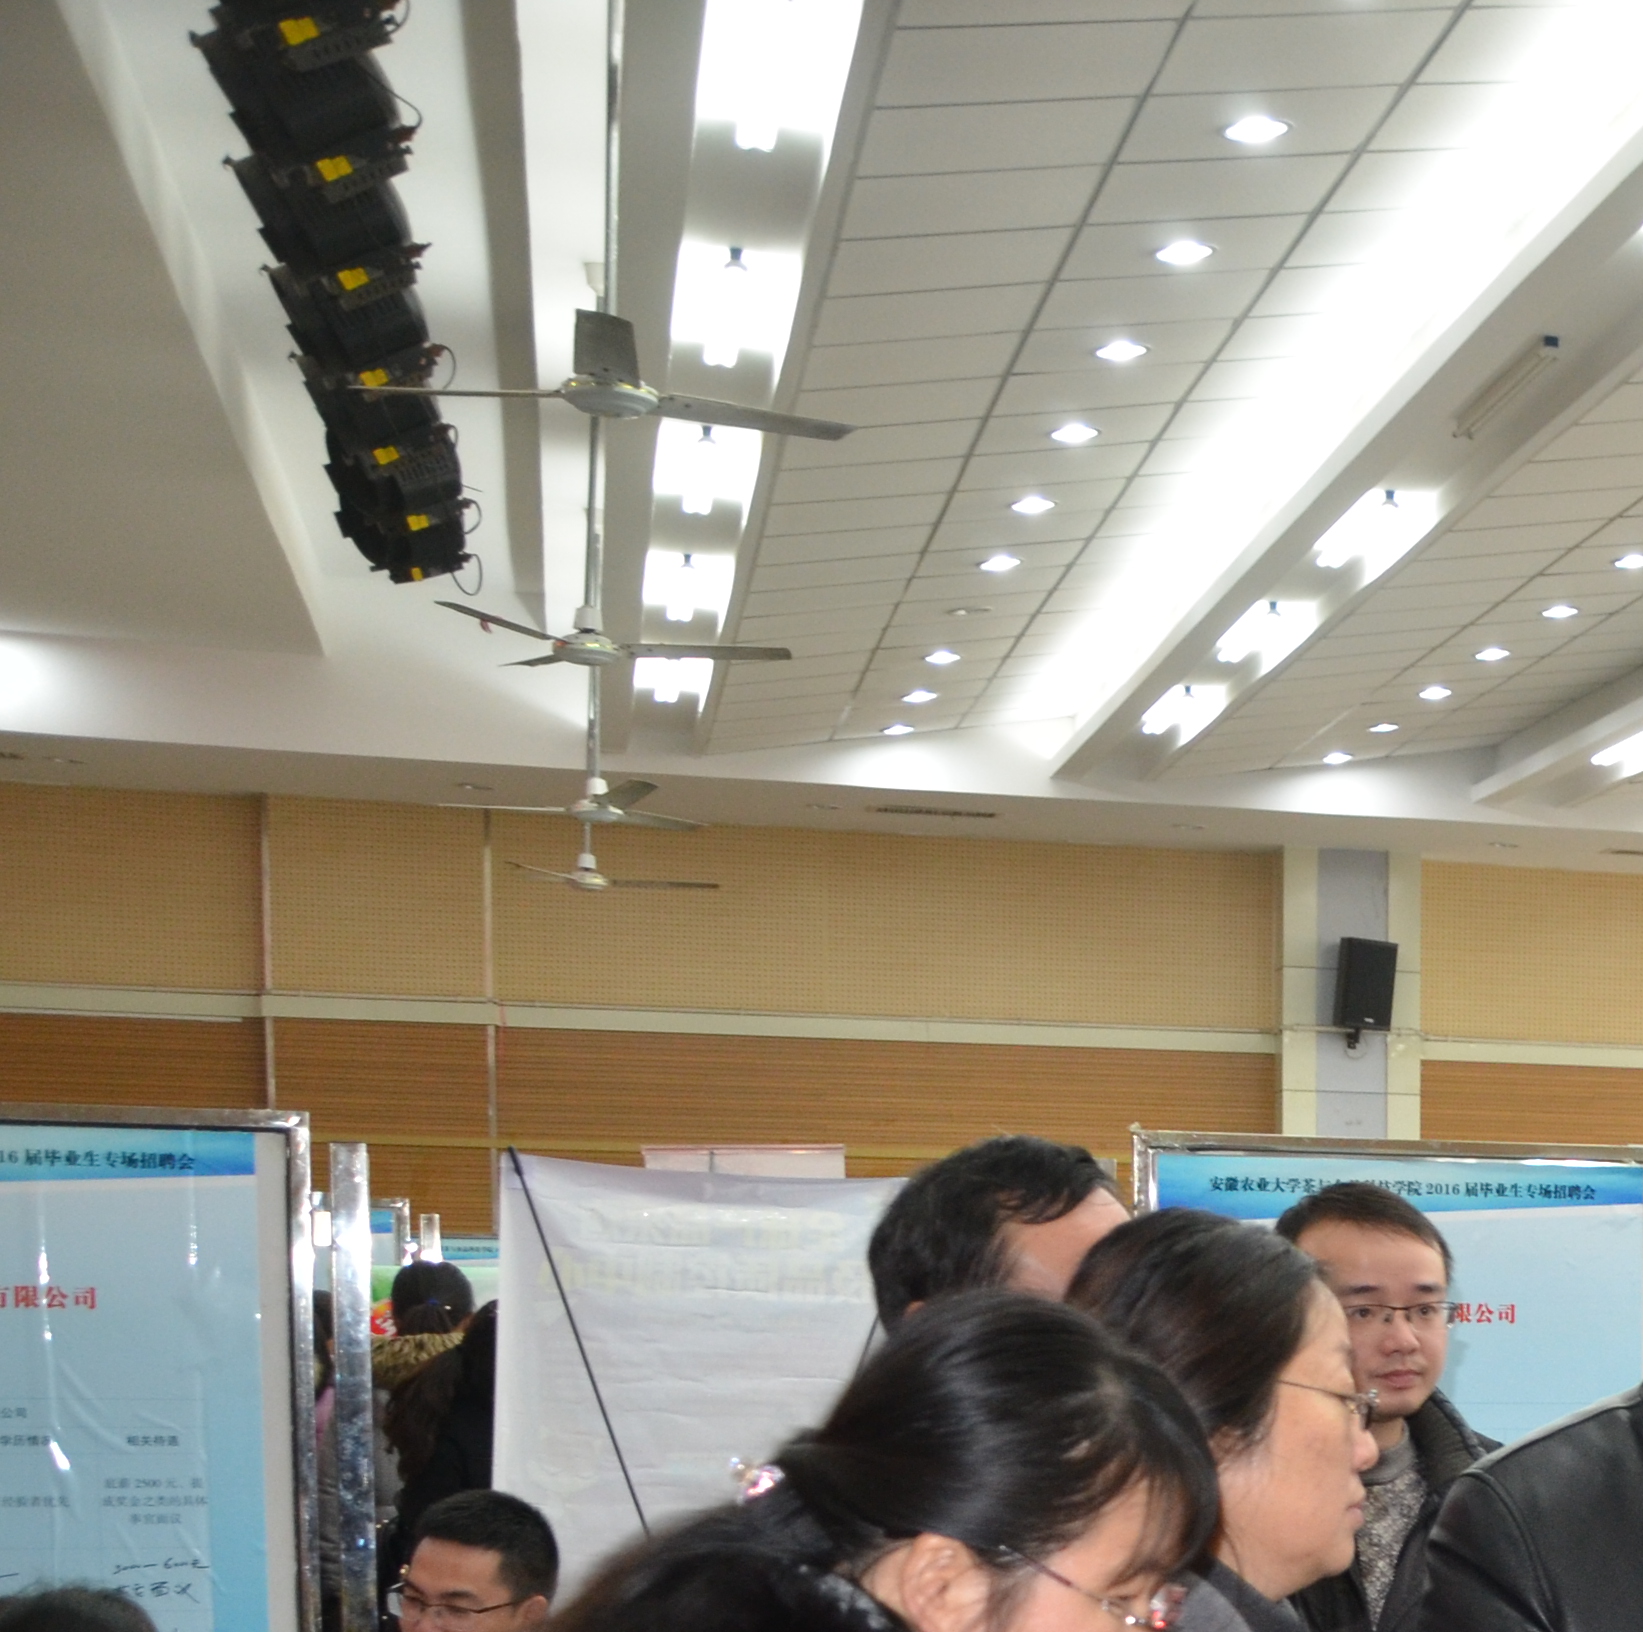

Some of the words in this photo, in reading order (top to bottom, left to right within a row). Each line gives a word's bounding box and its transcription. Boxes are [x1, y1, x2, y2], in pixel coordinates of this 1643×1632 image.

[1208, 1175, 1596, 1201] 安徽农业大学茶与技学院2016届毕业生专场招聘会
